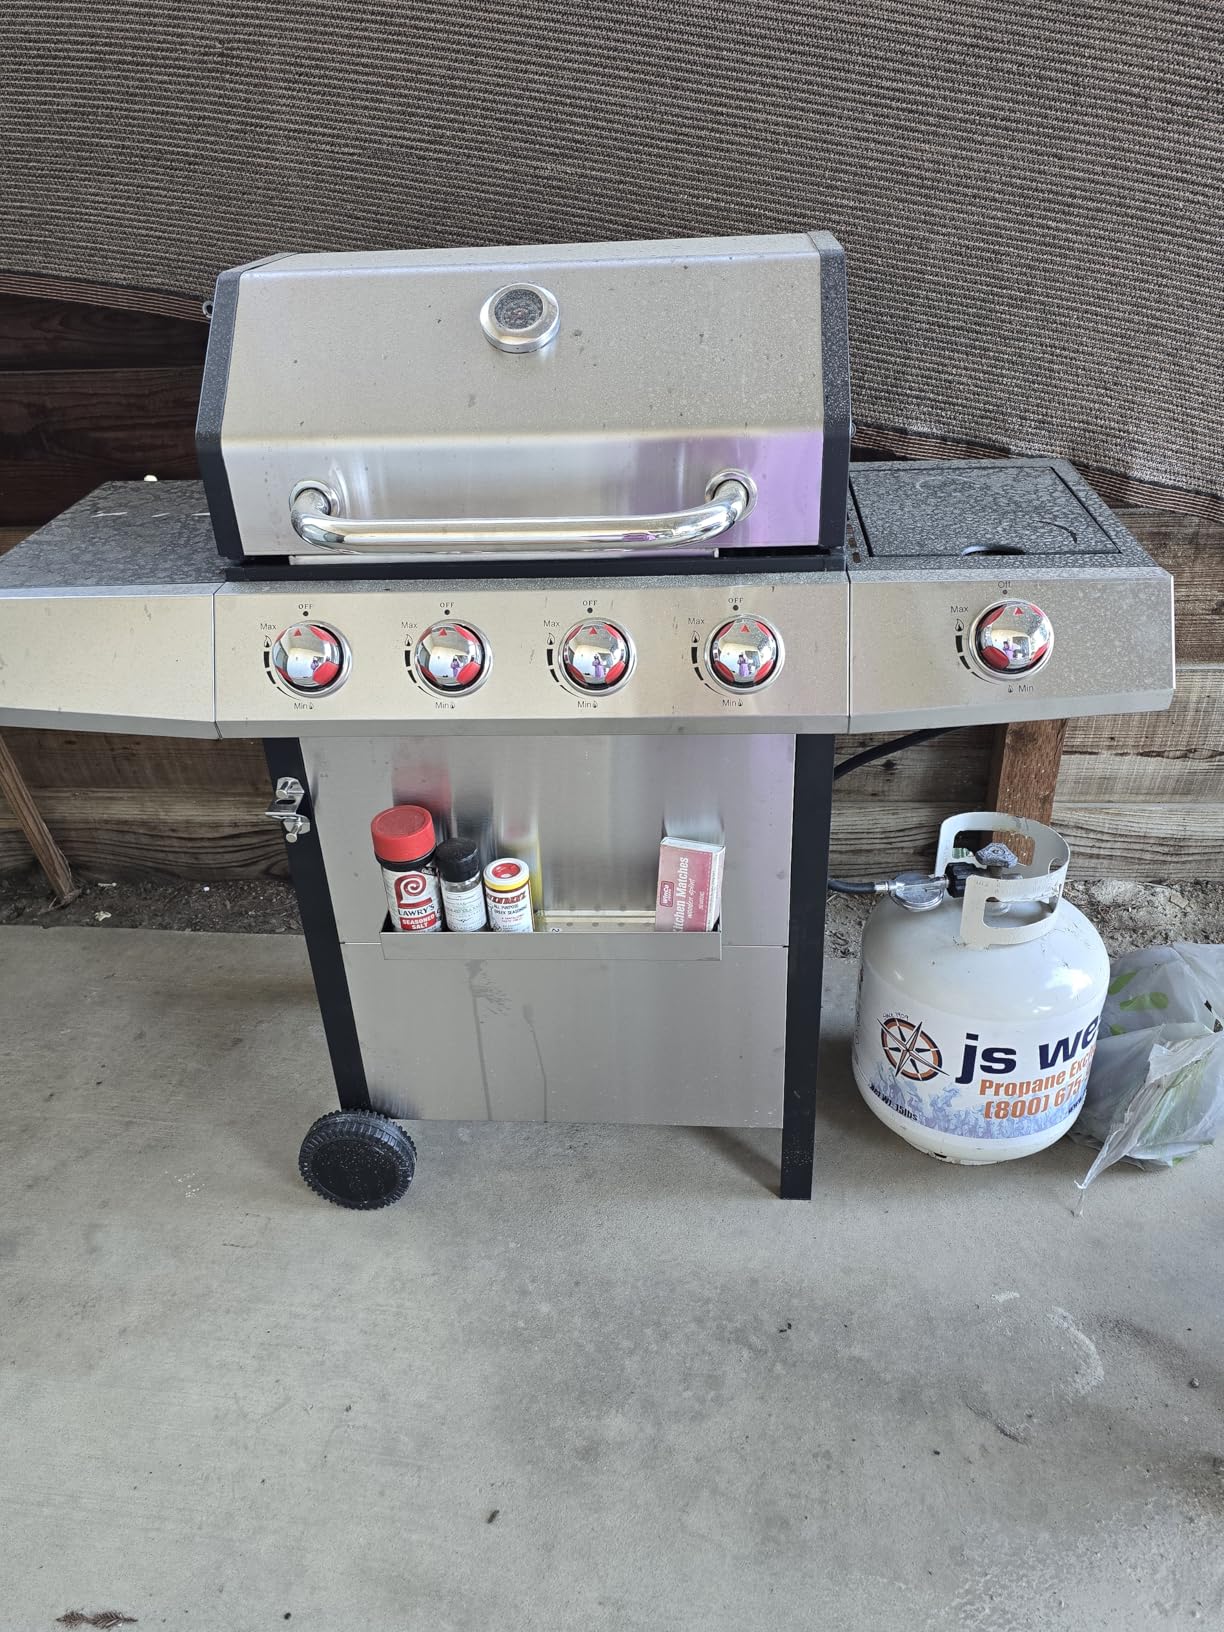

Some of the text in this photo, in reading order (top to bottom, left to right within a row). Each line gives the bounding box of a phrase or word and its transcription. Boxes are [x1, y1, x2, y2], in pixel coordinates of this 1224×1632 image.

[950, 605, 968, 613] Max
[543, 619, 560, 628] Max
[687, 616, 705, 625] Max
[260, 622, 277, 631] Max
[401, 621, 418, 630] Max
[1018, 684, 1034, 693] Min
[293, 702, 308, 711] Min
[435, 701, 450, 710] Min
[577, 700, 592, 709] Min
[722, 699, 737, 708] Min
[673, 857, 689, 932] itchen Matches
[398, 904, 434, 916] LAWRY'S
[402, 914, 435, 925] SEASONED
[411, 922, 428, 930] SALT
[955, 1032, 1017, 1085] js
[979, 1070, 1066, 1098] Propane
[984, 1094, 1050, 1120] (800)
